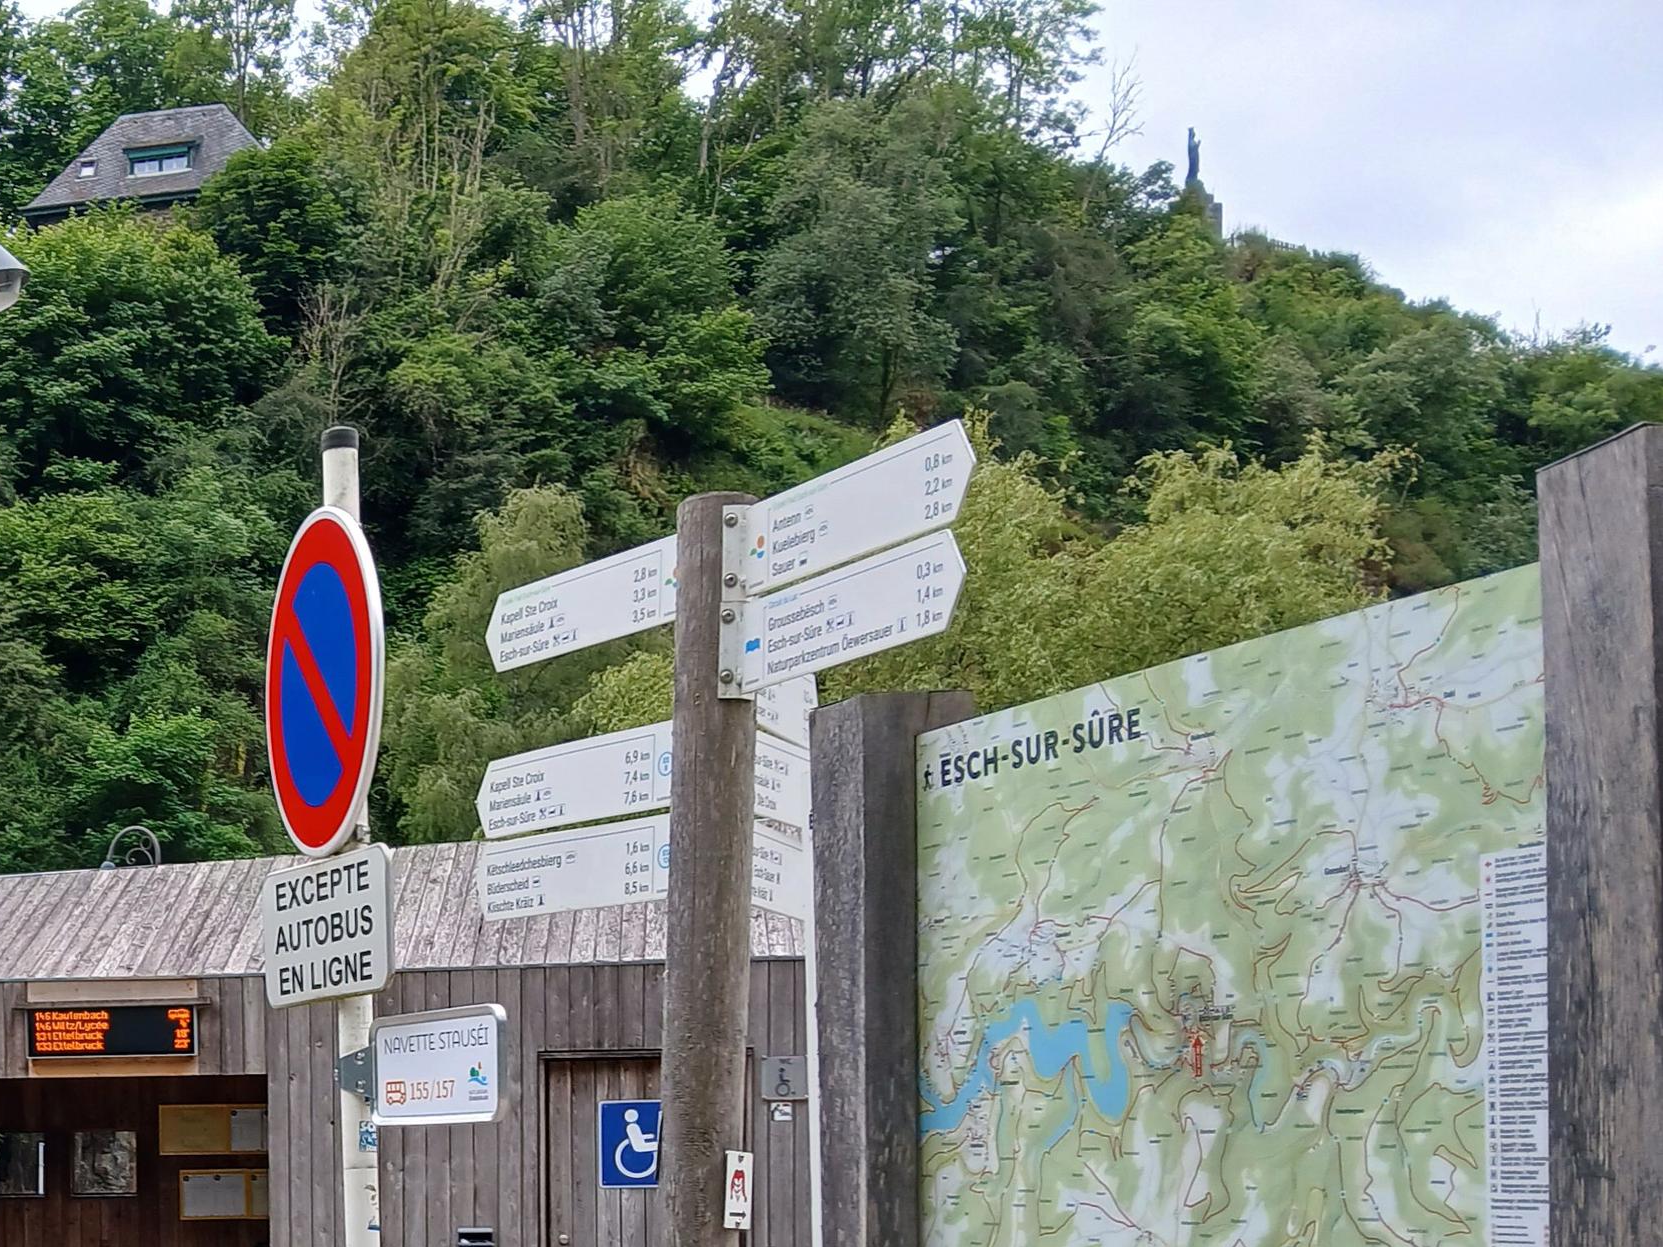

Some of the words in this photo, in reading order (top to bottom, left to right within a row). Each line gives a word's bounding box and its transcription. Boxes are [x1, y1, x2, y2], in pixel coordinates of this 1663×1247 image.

[772, 511, 801, 532] Antenn
[924, 453, 940, 472] 0,8
[941, 453, 953, 464] km
[924, 477, 940, 496] 2,2
[941, 477, 953, 488] km
[772, 558, 795, 576] Sauer
[924, 501, 940, 520] 2,8
[941, 502, 953, 513] km
[917, 561, 931, 581] 0,3
[932, 562, 944, 573] km
[539, 598, 558, 613] Croix
[633, 567, 646, 583] 2,8
[648, 568, 657, 578] km
[633, 588, 645, 603] 3,3
[647, 589, 657, 599] km
[632, 608, 645, 623] 3,5
[647, 609, 656, 619] km
[767, 624, 822, 653] Esch-sur-Sûre
[917, 587, 931, 604] 1,4
[932, 586, 944, 598] km
[767, 642, 840, 675] Naturparkzentrum
[916, 610, 930, 627] 1,8
[931, 610, 943, 622] km
[625, 750, 638, 765] 6,9
[640, 751, 650, 761] km
[939, 708, 1141, 787] ESCH-SUR-SÛRE
[624, 770, 638, 785] 7,4
[640, 771, 649, 782] km
[639, 792, 649, 802] km
[640, 842, 649, 852] km
[640, 862, 649, 873] km
[276, 860, 369, 911] EXCEPTE
[624, 881, 638, 896] 8,5
[639, 883, 649, 893] km
[276, 905, 373, 954] AUTOBUS
[279, 966, 303, 995] EN
[311, 950, 372, 990] LIGNE
[384, 1033, 436, 1054] NAVETTE
[439, 1023, 489, 1050] STAUSÉI
